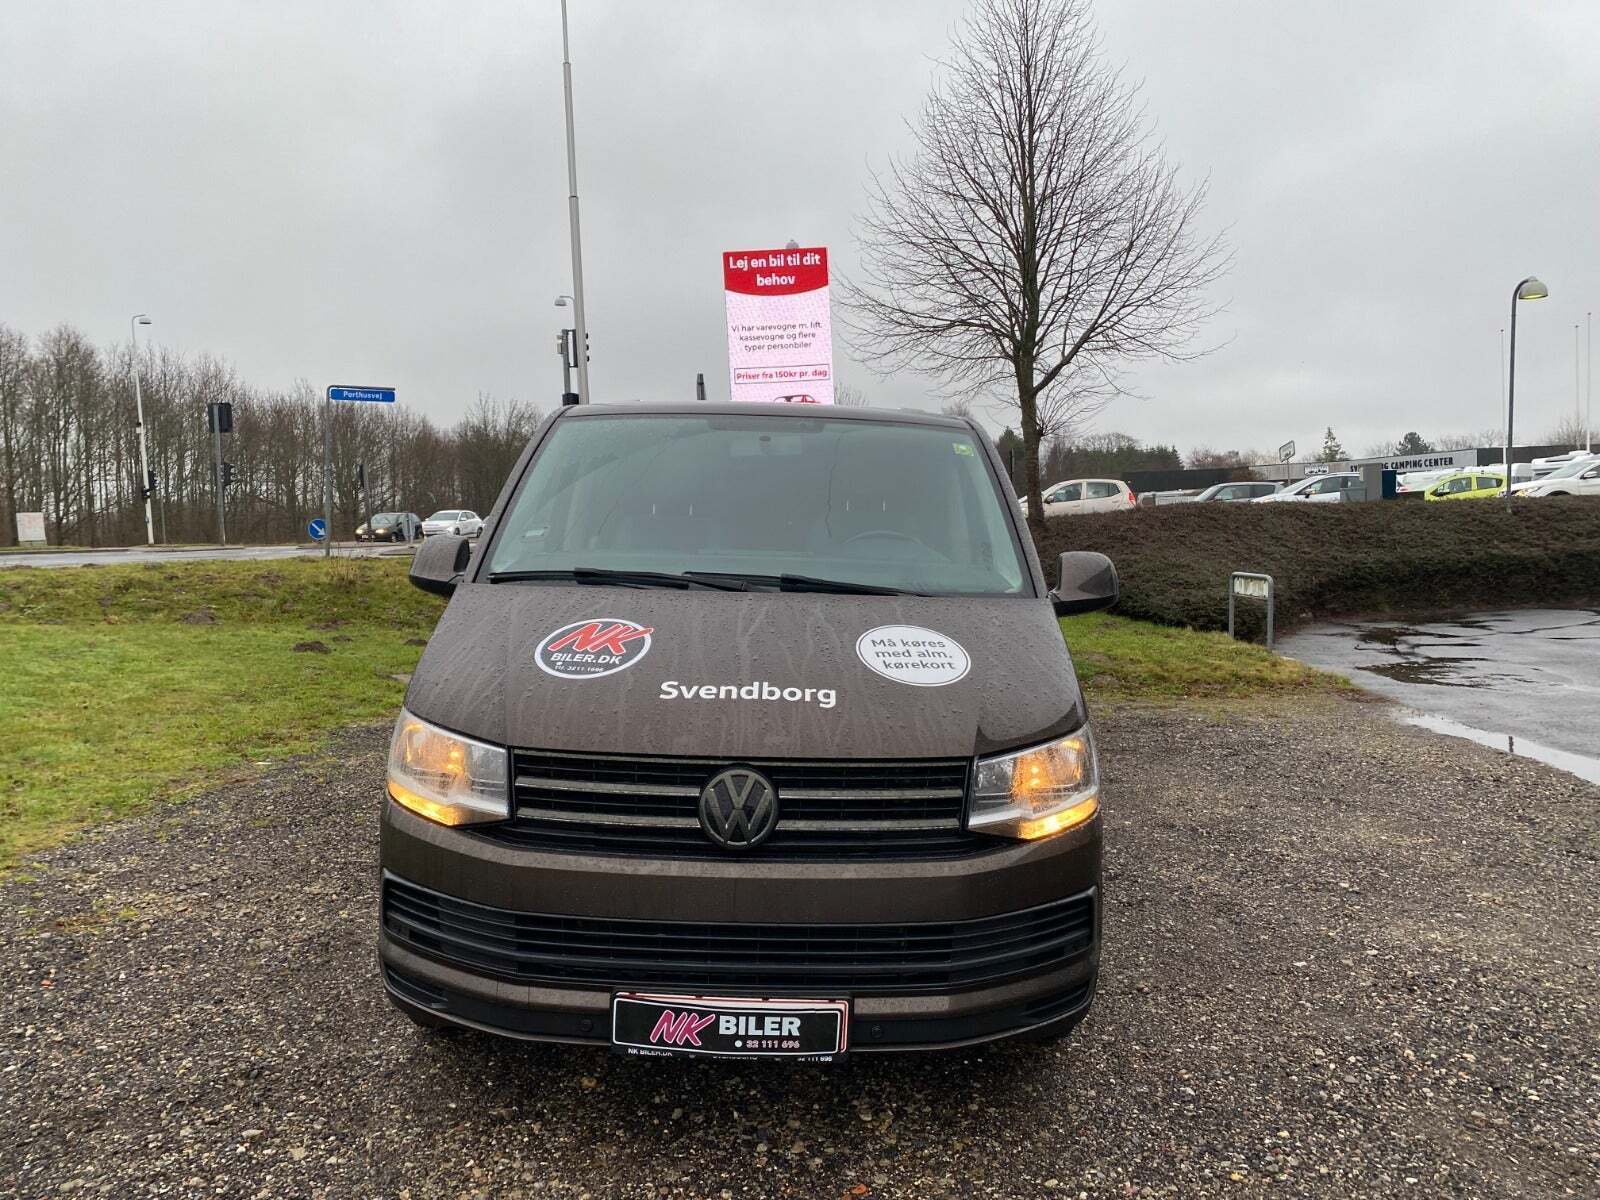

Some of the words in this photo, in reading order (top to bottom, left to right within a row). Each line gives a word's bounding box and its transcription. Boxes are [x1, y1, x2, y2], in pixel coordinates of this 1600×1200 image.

[729, 256, 748, 271] Lej
[751, 258, 766, 268] en
[769, 254, 784, 267] bil
[787, 254, 800, 266] til
[803, 253, 820, 265] dit
[756, 273, 795, 286] behov
[742, 323, 754, 331] har
[756, 322, 796, 331] varevogne
[799, 331, 816, 339] flere
[744, 344, 765, 352] typer
[767, 342, 812, 350] personbiler
[762, 371, 773, 379] fra
[775, 370, 797, 378] 150kr
[343, 391, 382, 400] Porthusvej
[1391, 460, 1422, 469] CAMPING
[1424, 457, 1453, 467] CENTER
[548, 622, 655, 655] NK
[871, 639, 897, 648] Må
[901, 639, 945, 648] køres
[550, 653, 622, 665] BILER.DK
[875, 650, 912, 659] med
[883, 660, 954, 670] kørekort
[659, 681, 837, 708] Svendborg
[650, 1010, 716, 1046] NK
[718, 1015, 800, 1036] BILER
[746, 1041, 759, 1049] 32
[761, 1041, 779, 1049] 111
[781, 1041, 800, 1049] 696
